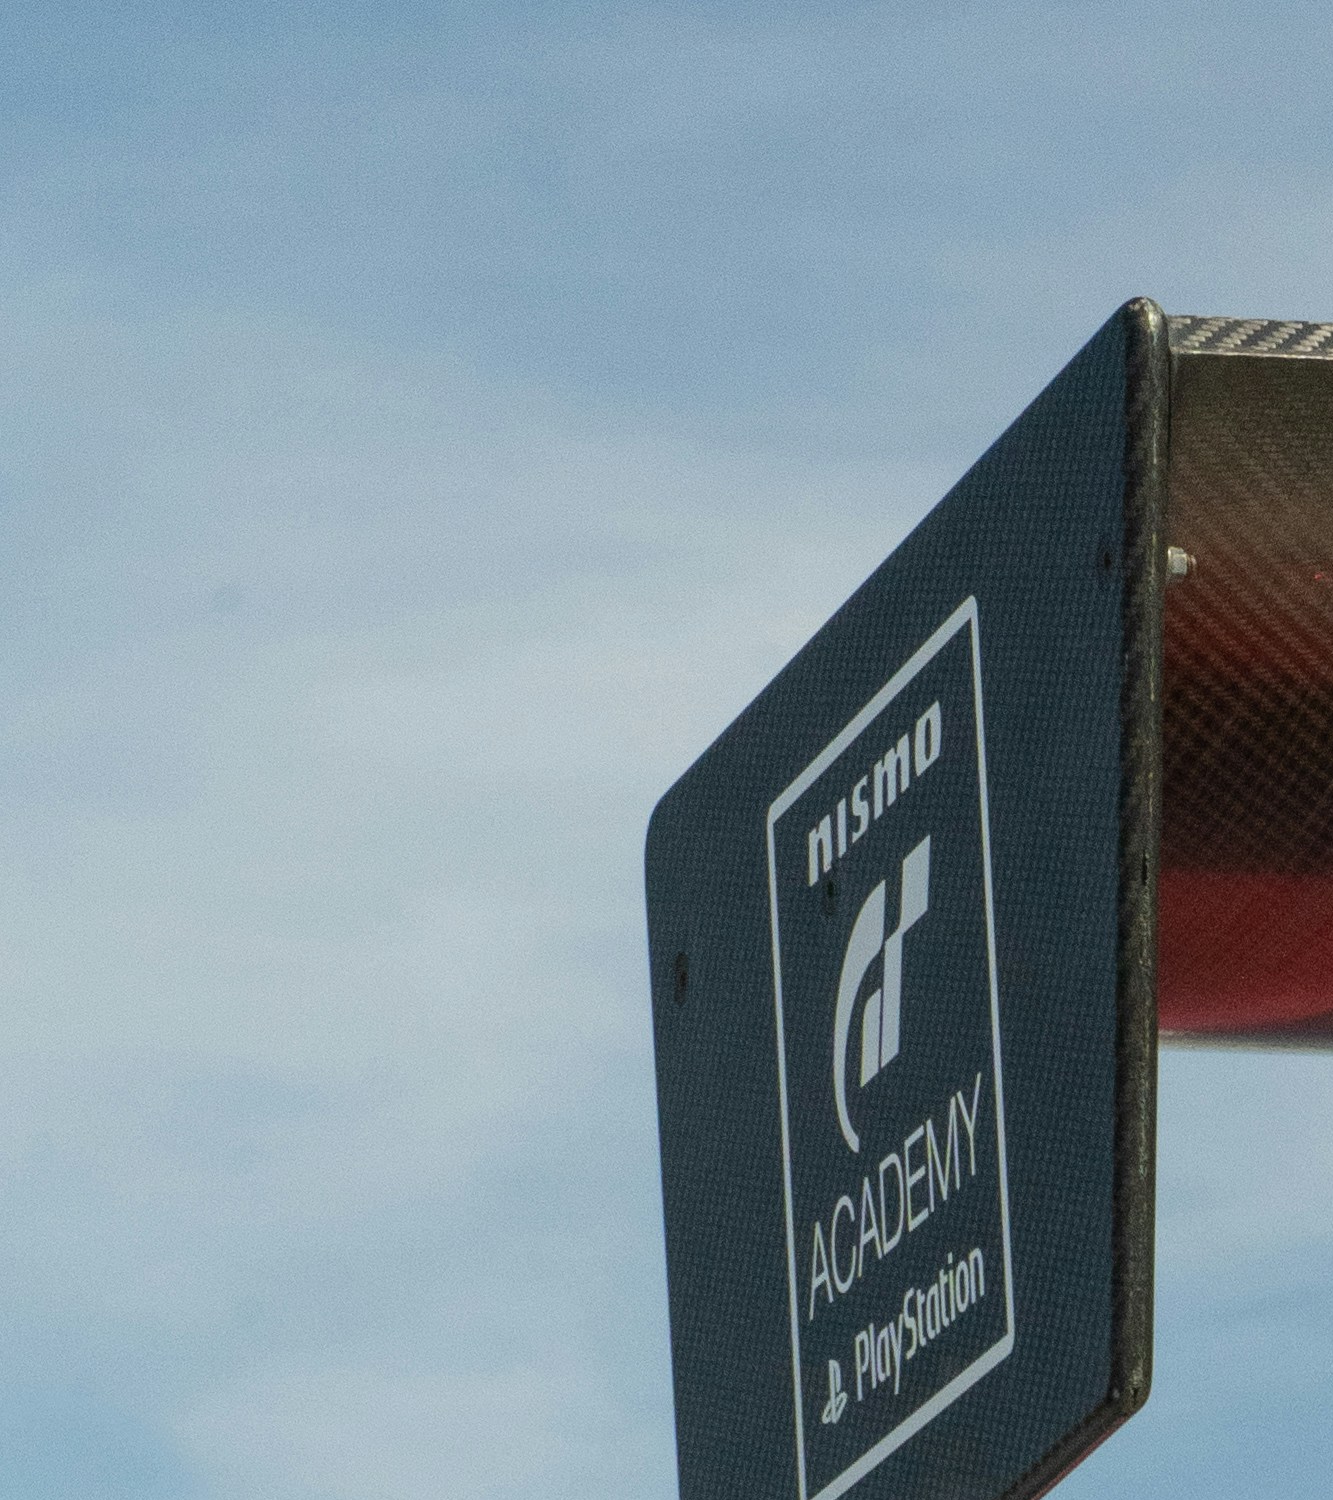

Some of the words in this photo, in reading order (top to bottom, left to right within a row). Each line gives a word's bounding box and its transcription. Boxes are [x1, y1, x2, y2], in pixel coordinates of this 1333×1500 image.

[808, 700, 942, 887] nismo
[809, 1073, 982, 1320] ACADEMY
[857, 1247, 985, 1400] PlayStation
